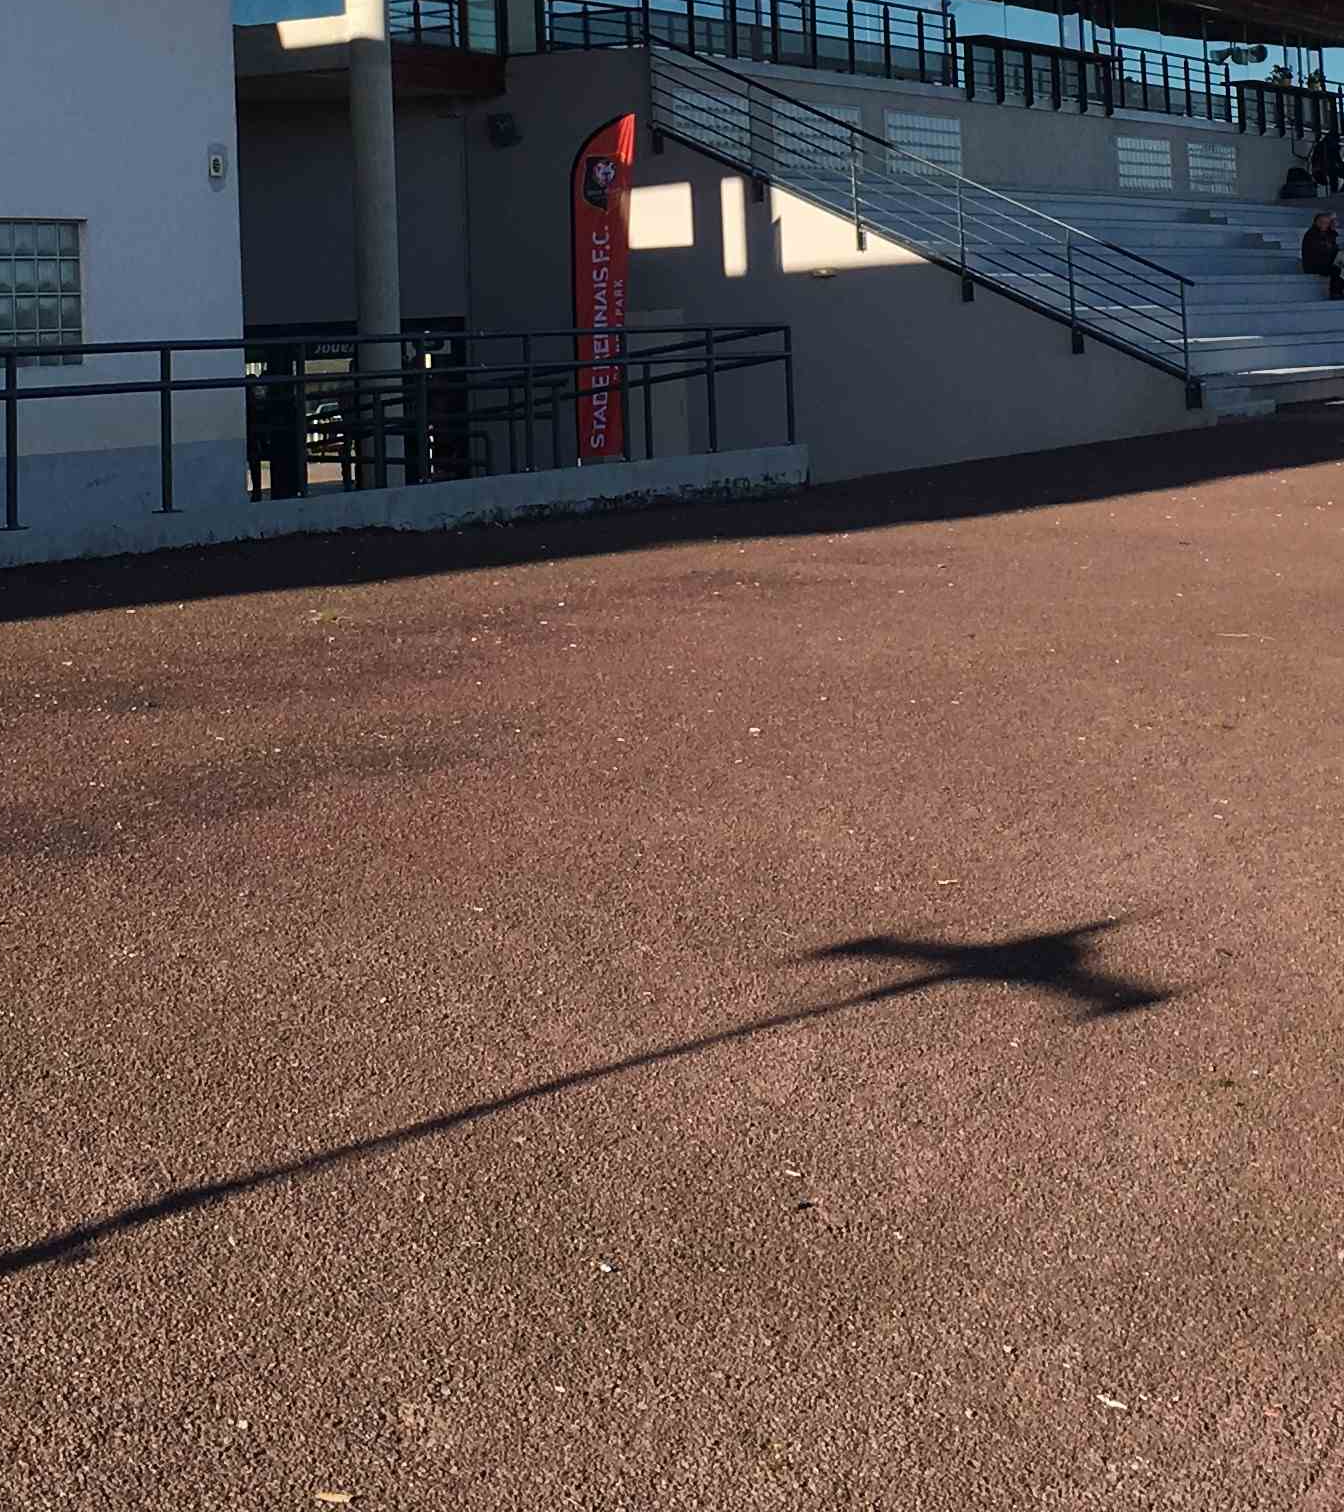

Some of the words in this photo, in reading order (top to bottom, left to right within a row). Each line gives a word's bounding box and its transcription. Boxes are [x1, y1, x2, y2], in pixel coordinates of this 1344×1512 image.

[592, 225, 610, 263] F.C.
[614, 279, 625, 317] PARK
[591, 376, 610, 448] STADE
